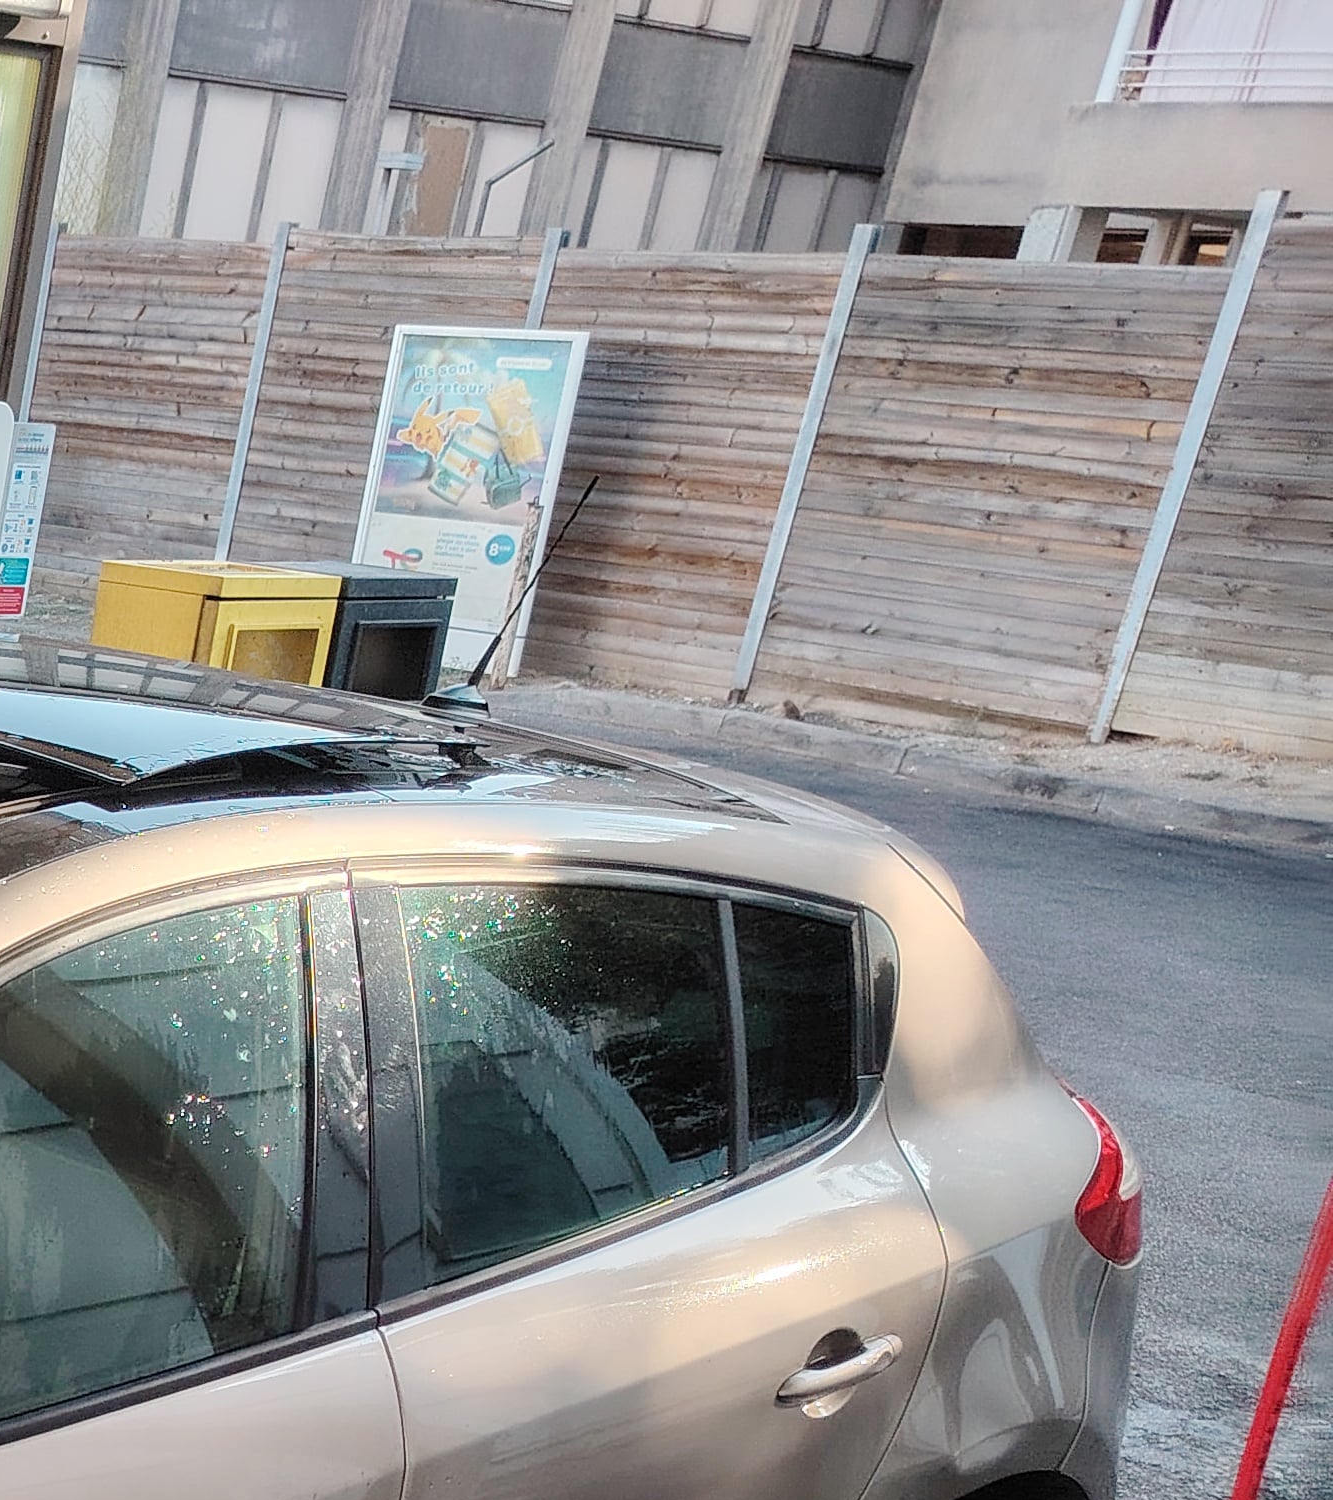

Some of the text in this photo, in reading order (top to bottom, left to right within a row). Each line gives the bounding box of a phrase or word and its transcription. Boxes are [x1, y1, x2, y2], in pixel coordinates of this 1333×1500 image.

[438, 361, 475, 377] sont
[413, 382, 432, 393] de
[436, 382, 484, 394] retour
